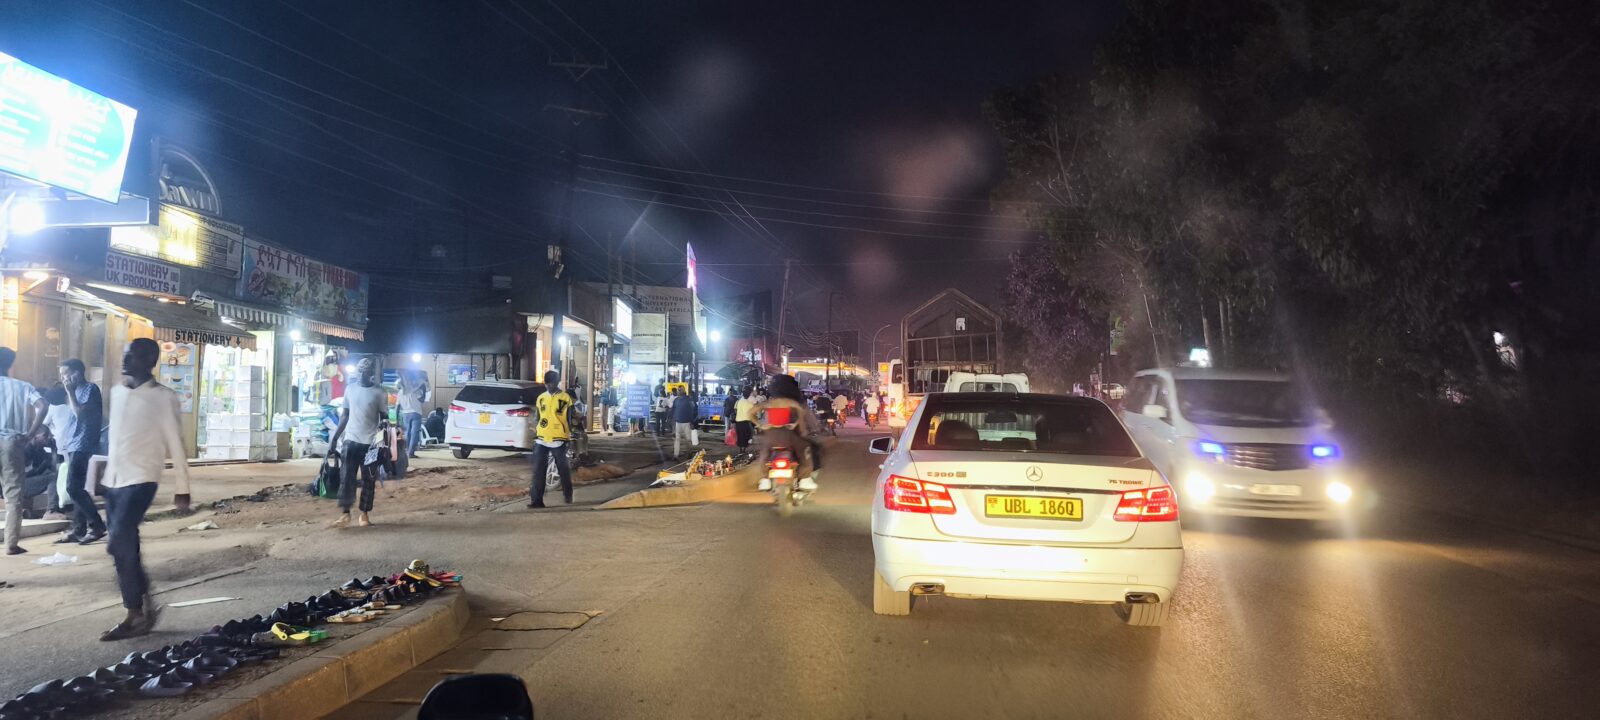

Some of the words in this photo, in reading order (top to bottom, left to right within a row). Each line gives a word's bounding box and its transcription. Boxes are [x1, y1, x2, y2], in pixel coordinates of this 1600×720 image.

[106, 254, 168, 280] STATIONERY
[106, 270, 120, 282] UK
[122, 273, 170, 292] PRODUCTS
[175, 330, 232, 346] STATIONERY
[1004, 498, 1031, 514] UBL
[1040, 500, 1074, 516] 186Q
